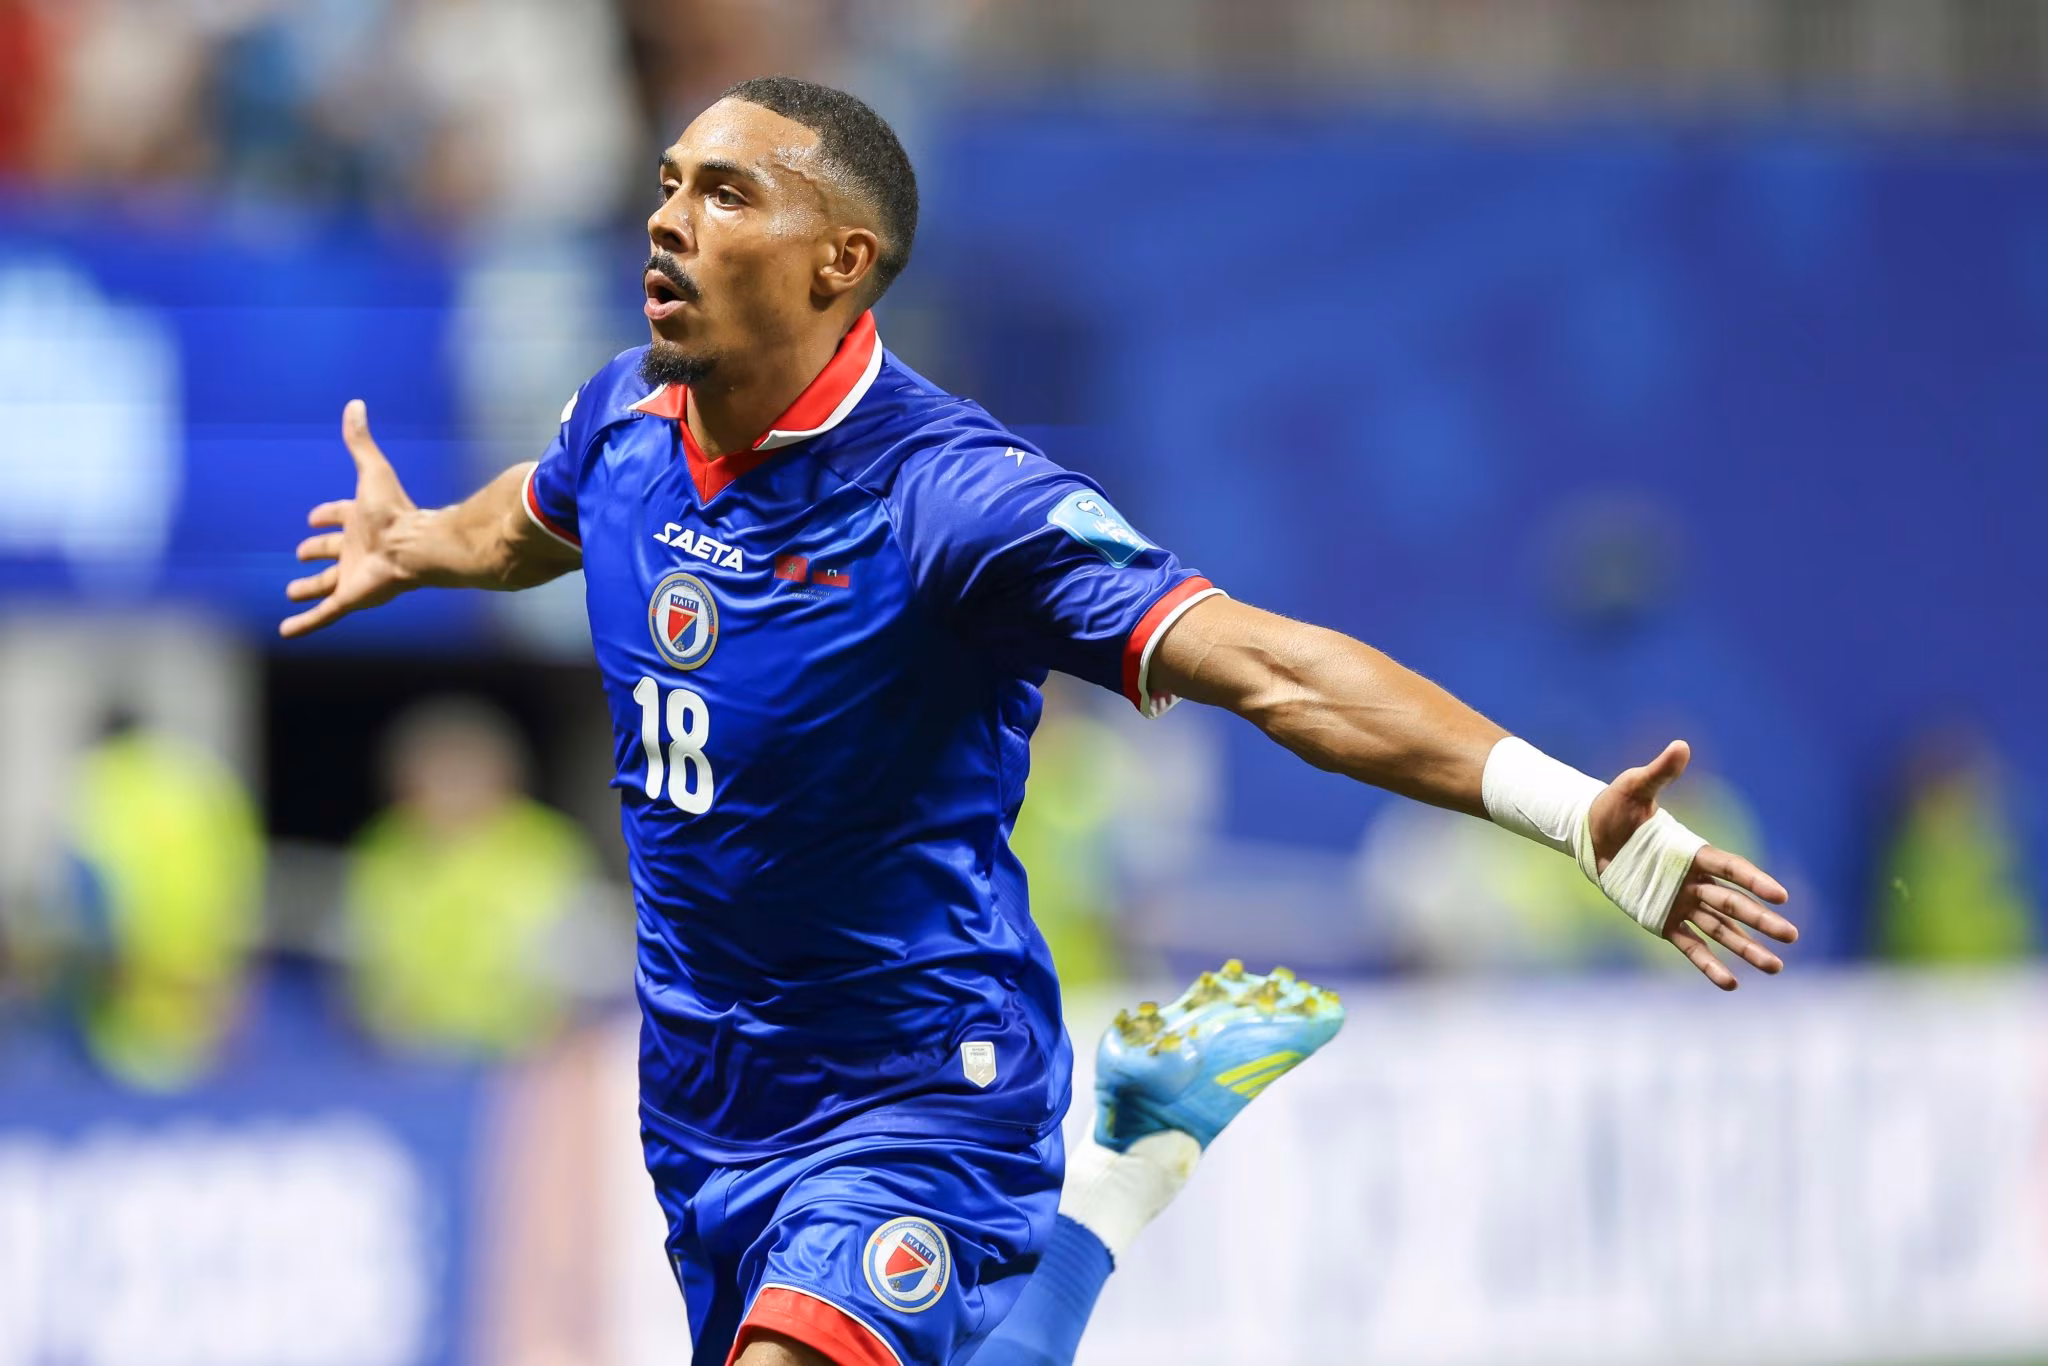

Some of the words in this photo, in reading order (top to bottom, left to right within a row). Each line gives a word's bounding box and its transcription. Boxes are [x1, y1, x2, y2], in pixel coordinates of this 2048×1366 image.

[653, 522, 744, 572] SAETA
[672, 596, 697, 610] HAITI
[633, 676, 714, 815] 18
[906, 1236, 934, 1261] HAITI
